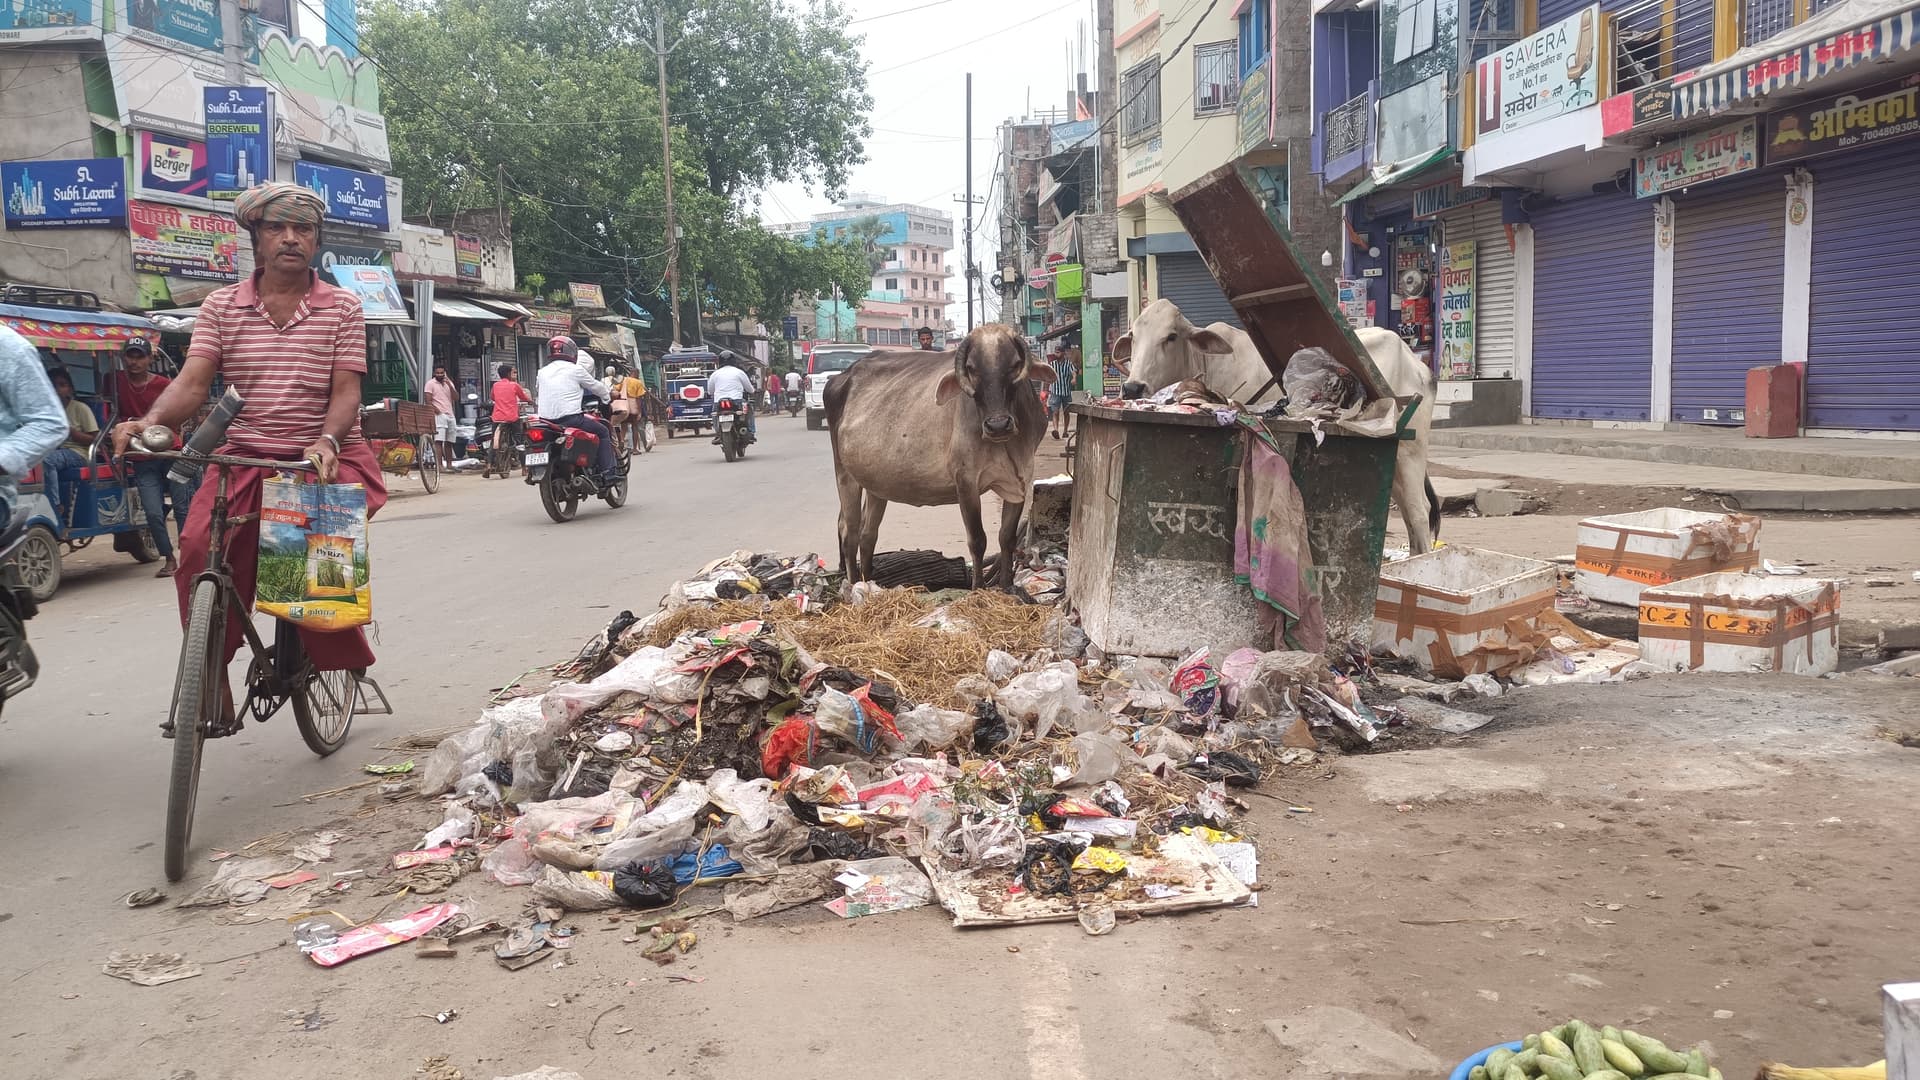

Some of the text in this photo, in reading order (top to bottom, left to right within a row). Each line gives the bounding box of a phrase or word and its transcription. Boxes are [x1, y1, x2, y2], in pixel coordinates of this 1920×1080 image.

[1505, 28, 1567, 70] SAVERA
[1522, 73, 1538, 90] No.1
[207, 103, 262, 114] Subh Laxmi
[1504, 92, 1538, 117] सवेरा
[1809, 87, 1919, 141] अम्बिका
[209, 124, 257, 133] BOREWELL
[1838, 134, 1860, 147] Mob-
[153, 155, 190, 175] Berger
[54, 185, 116, 201] Subh Laxmi
[336, 190, 381, 209] Subh Laxmi
[1416, 183, 1456, 217] VIMAL
[339, 254, 371, 266] INDIGO
[1441, 267, 1472, 288] विमल
[1442, 288, 1471, 310] ज्वेलर्स
[1455, 320, 1472, 339] हाउस
[129, 337, 145, 346] BOY
